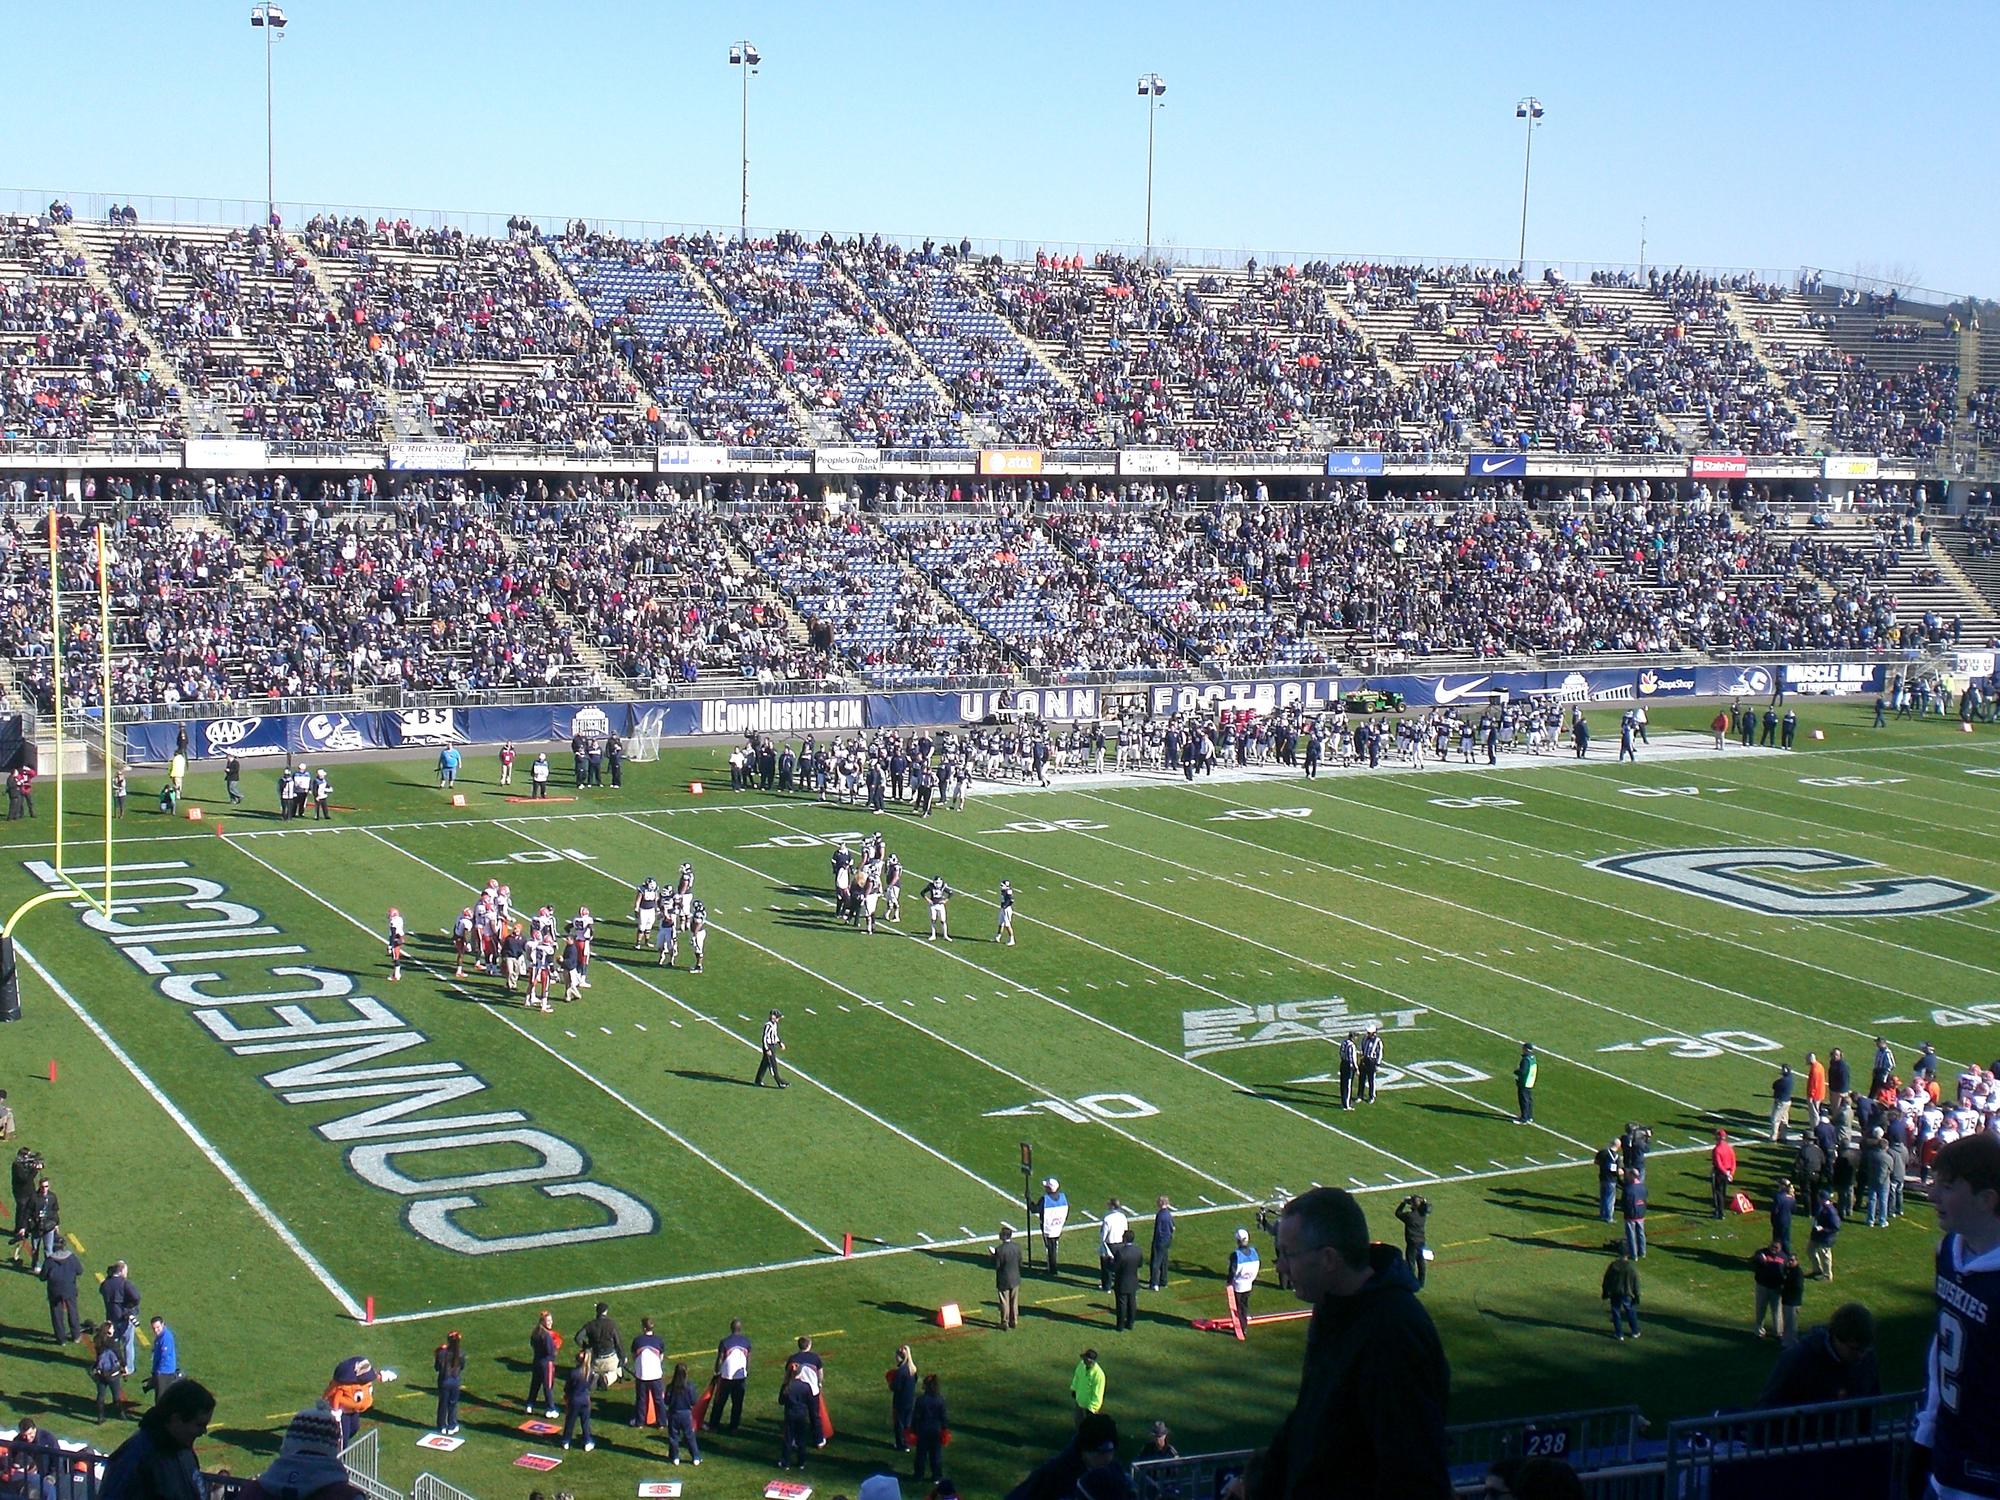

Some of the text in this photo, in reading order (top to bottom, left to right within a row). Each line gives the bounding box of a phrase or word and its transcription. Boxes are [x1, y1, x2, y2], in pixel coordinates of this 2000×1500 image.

[817, 456, 879, 464] People's United
[1704, 461, 1746, 472] State Farm
[1786, 664, 1876, 682] MUSCLE MILK
[210, 721, 241, 742] AAA
[1005, 819, 1109, 833] 30
[769, 832, 865, 849] 20
[509, 848, 599, 864] 10
[1183, 997, 1349, 1031] BIG
[1183, 1008, 1429, 1047] EAST
[1642, 1030, 1784, 1059] 30
[22, 860, 658, 1257] CONNECTICUT
[1031, 1093, 1161, 1123] 10
[1937, 1275, 1989, 1325] HUSKIES
[1938, 1308, 1967, 1414] 2
[1527, 1433, 1566, 1456] 238
